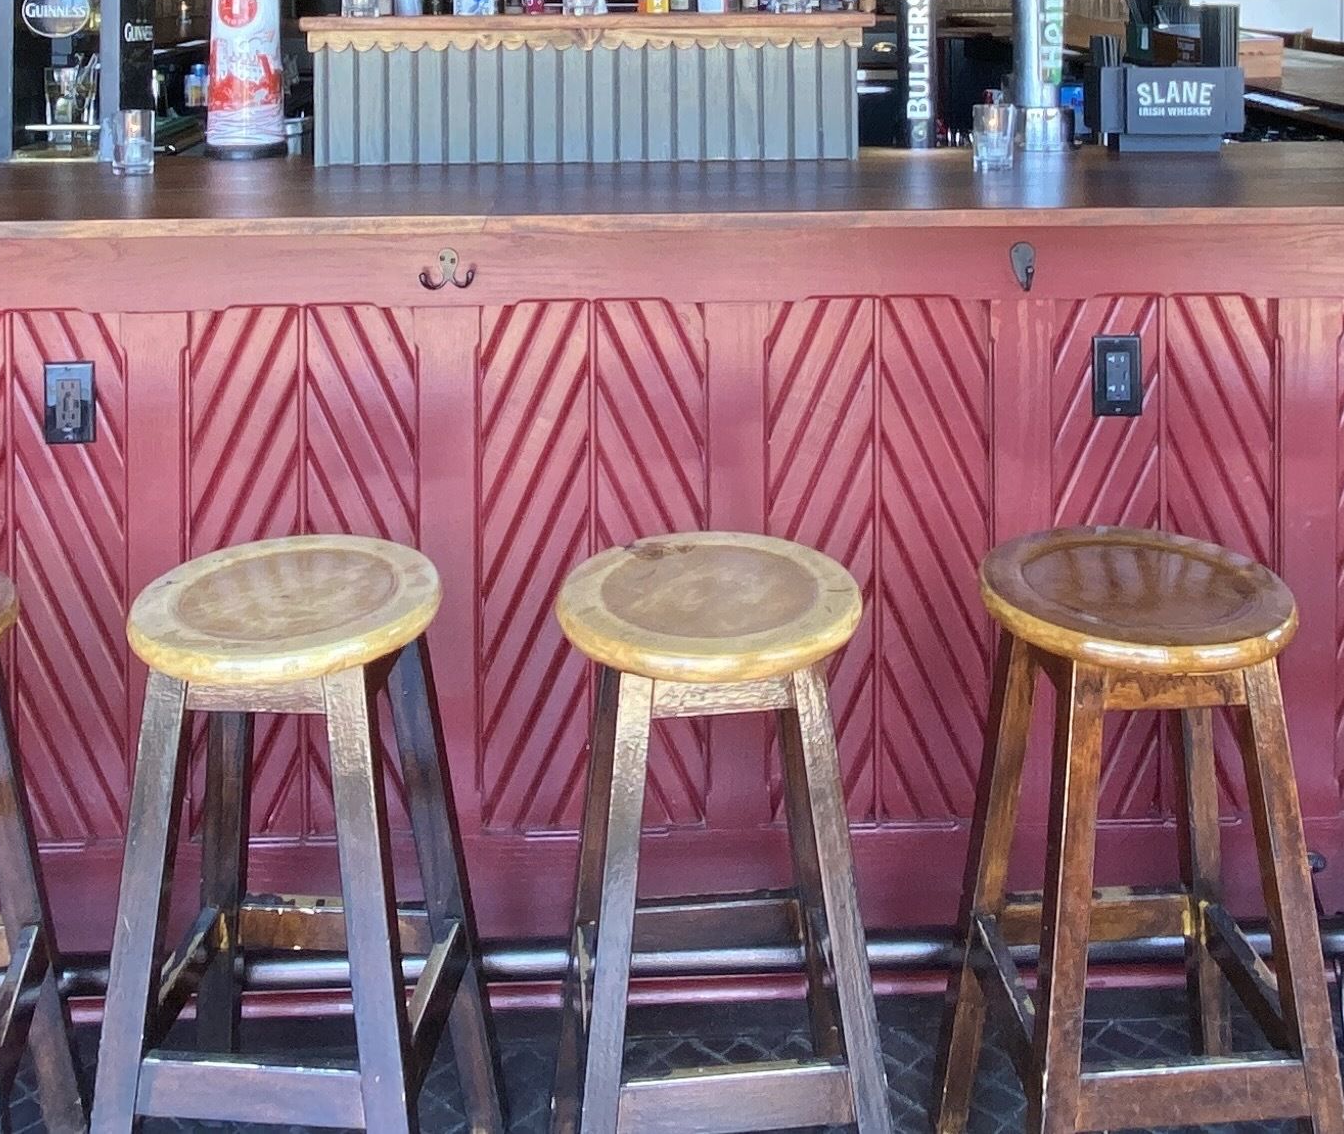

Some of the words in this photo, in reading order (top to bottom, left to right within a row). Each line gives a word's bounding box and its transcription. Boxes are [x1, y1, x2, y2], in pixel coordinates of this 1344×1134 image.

[25, 2, 86, 18] GUINNESS
[1137, 80, 1216, 106] SLANE
[1139, 106, 1166, 117] IRISH
[1168, 106, 1213, 117] WHISKEY
